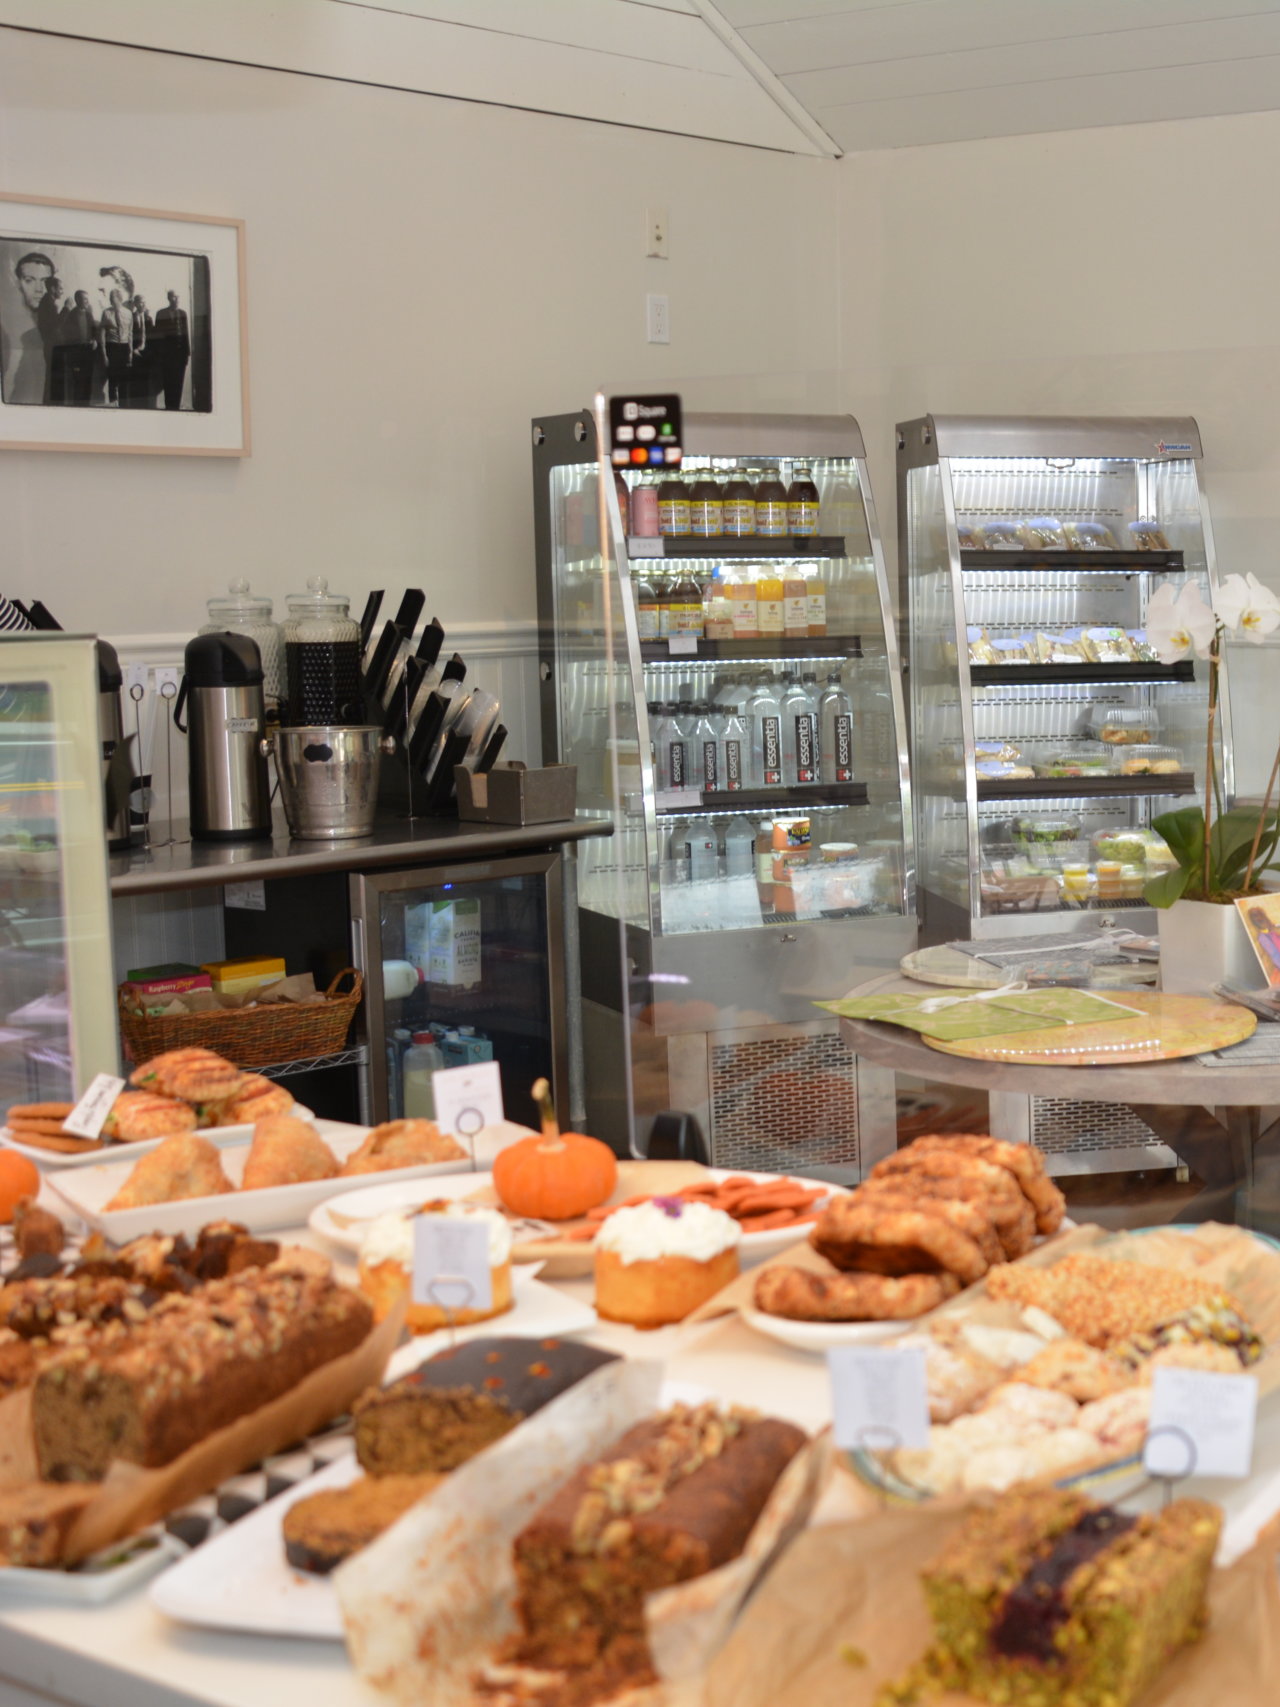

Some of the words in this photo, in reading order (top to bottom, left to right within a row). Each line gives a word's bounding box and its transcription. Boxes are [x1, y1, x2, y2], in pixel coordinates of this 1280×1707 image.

[765, 718, 777, 768] essentia
[798, 717, 810, 766] essentia
[837, 716, 848, 765] essentia
[672, 745, 681, 782] essentia
[706, 743, 715, 780] essentia
[728, 742, 737, 779] essentia
[148, 984, 176, 993] Raspberry
